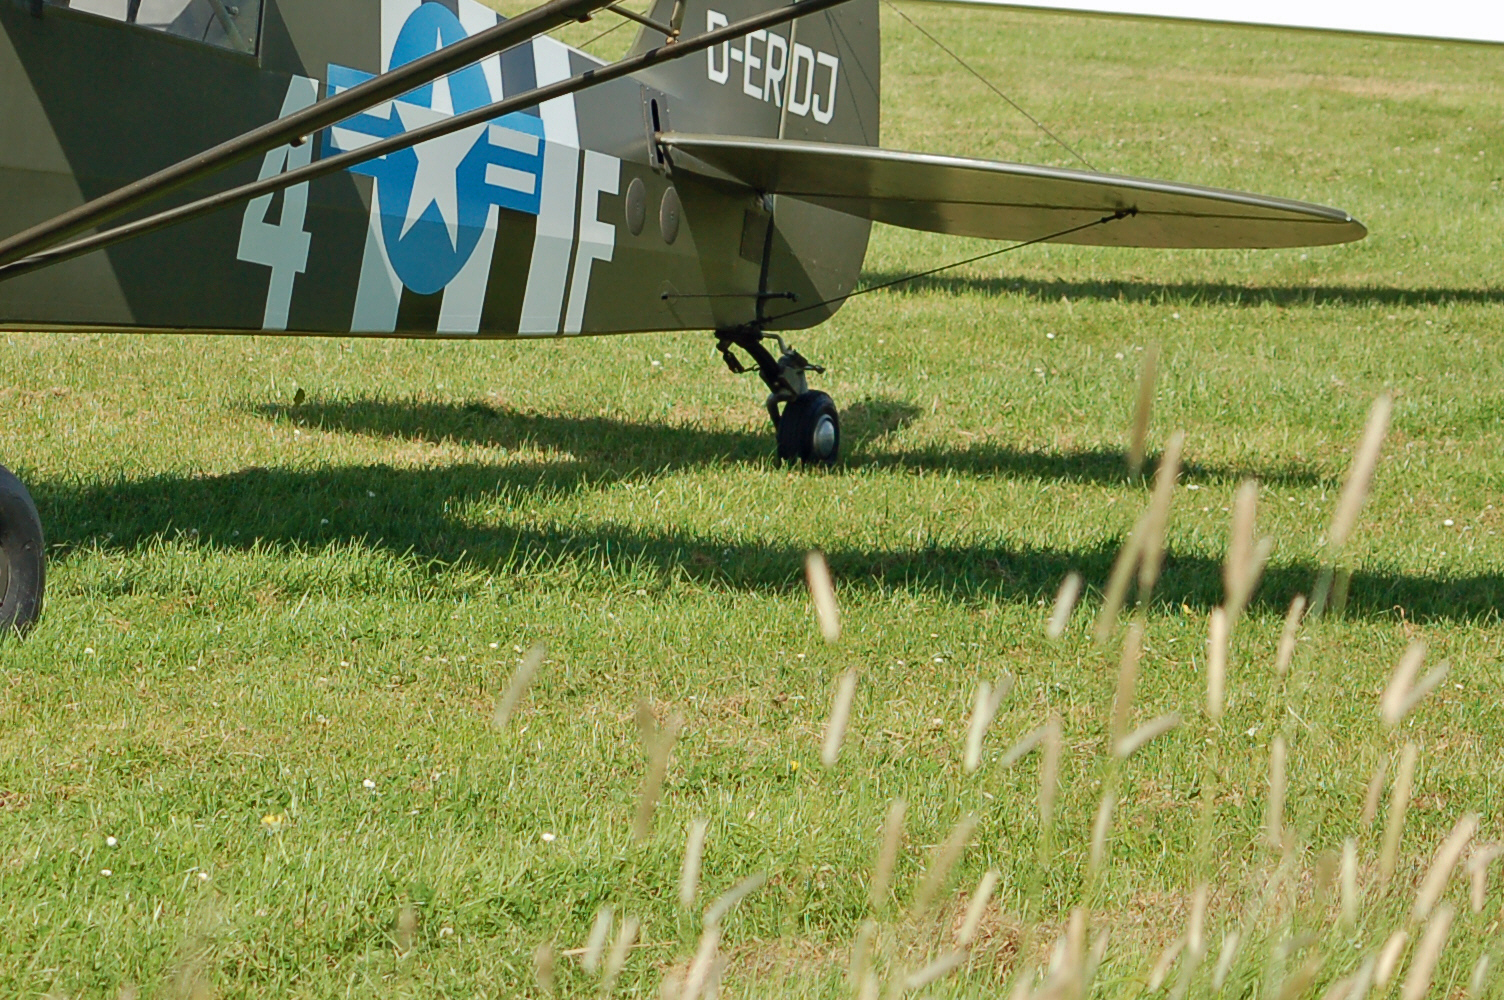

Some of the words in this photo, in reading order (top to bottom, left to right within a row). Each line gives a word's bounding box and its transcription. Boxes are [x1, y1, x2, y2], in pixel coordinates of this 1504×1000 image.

[707, 9, 838, 125] D-ERDJ
[237, 74, 319, 331] 4
[563, 149, 621, 335] F
